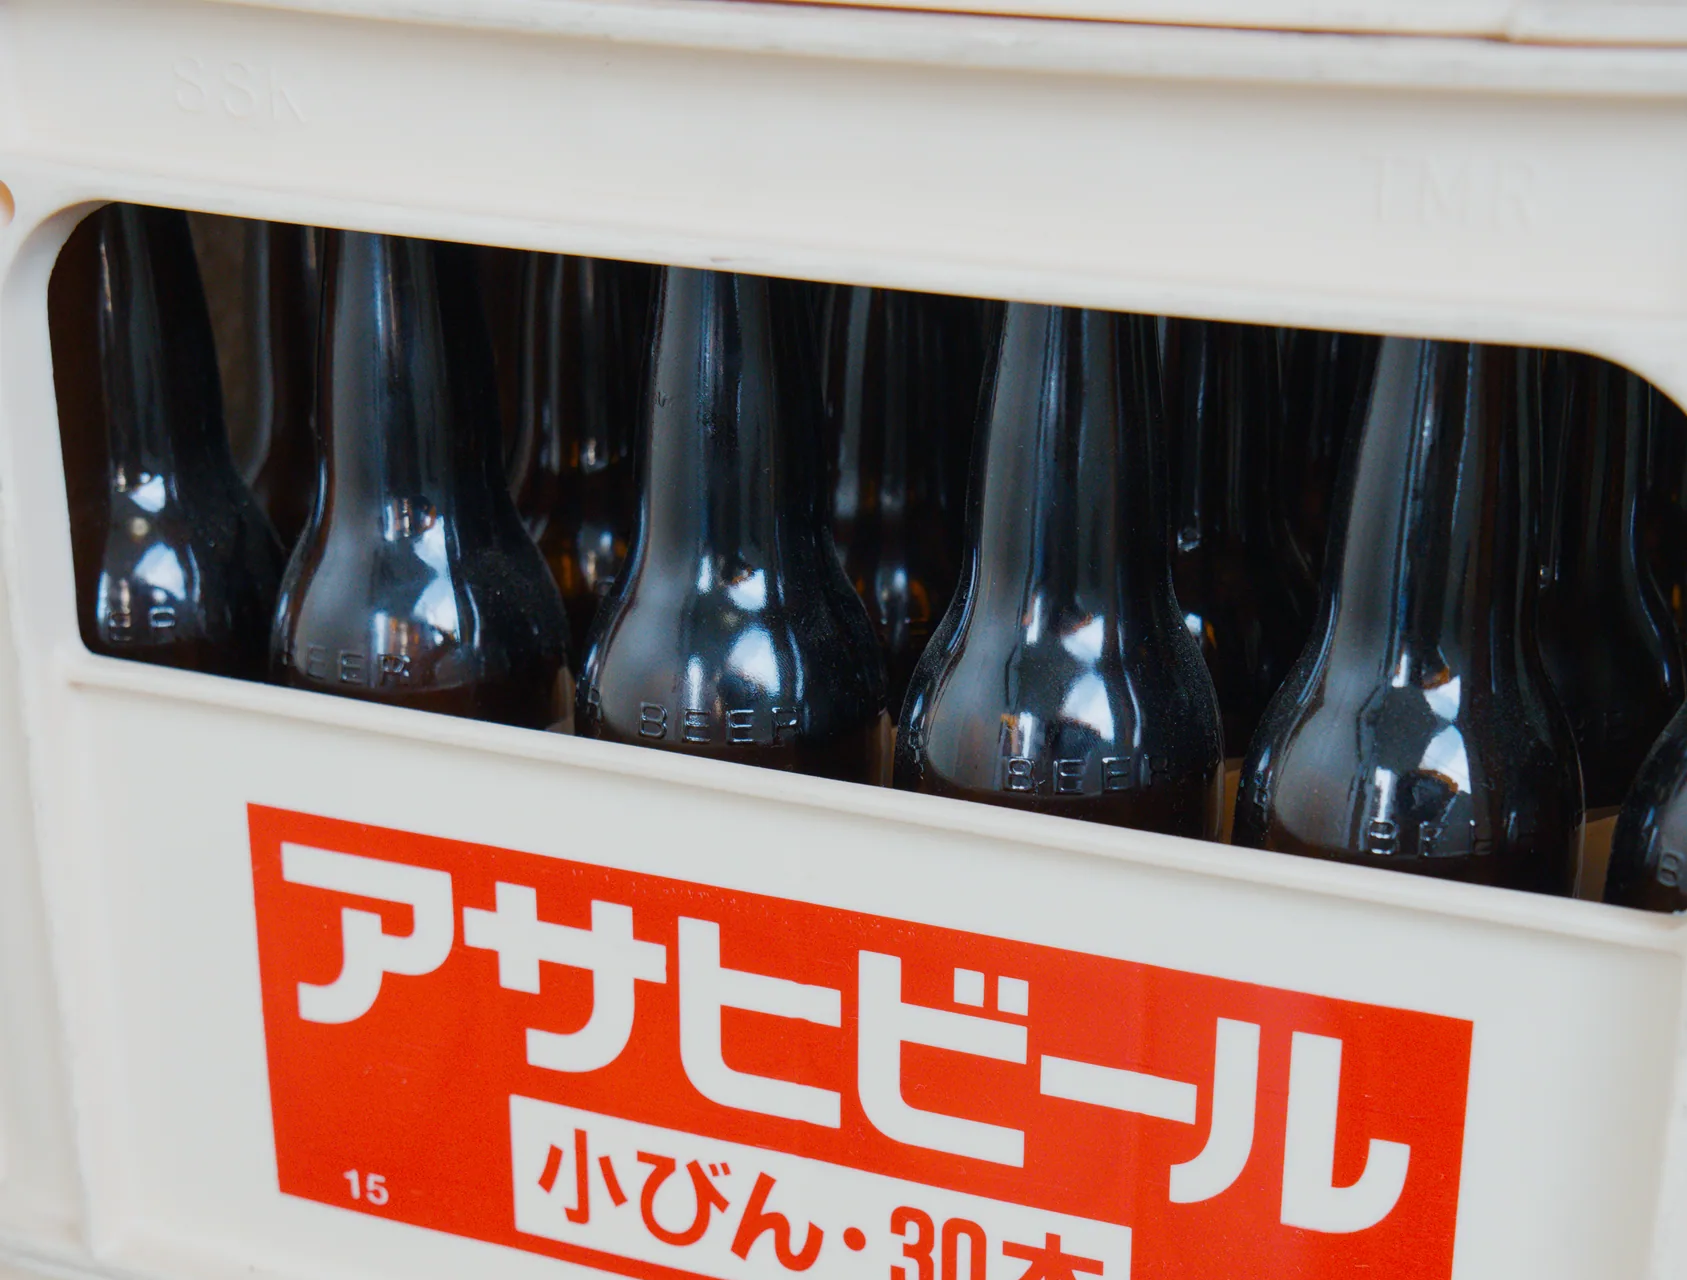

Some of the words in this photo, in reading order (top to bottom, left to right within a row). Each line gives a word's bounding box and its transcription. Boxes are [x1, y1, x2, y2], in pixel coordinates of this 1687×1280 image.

[638, 701, 803, 748] BEER
[280, 841, 1411, 1234] アサヒビール
[343, 1168, 389, 1206] 15
